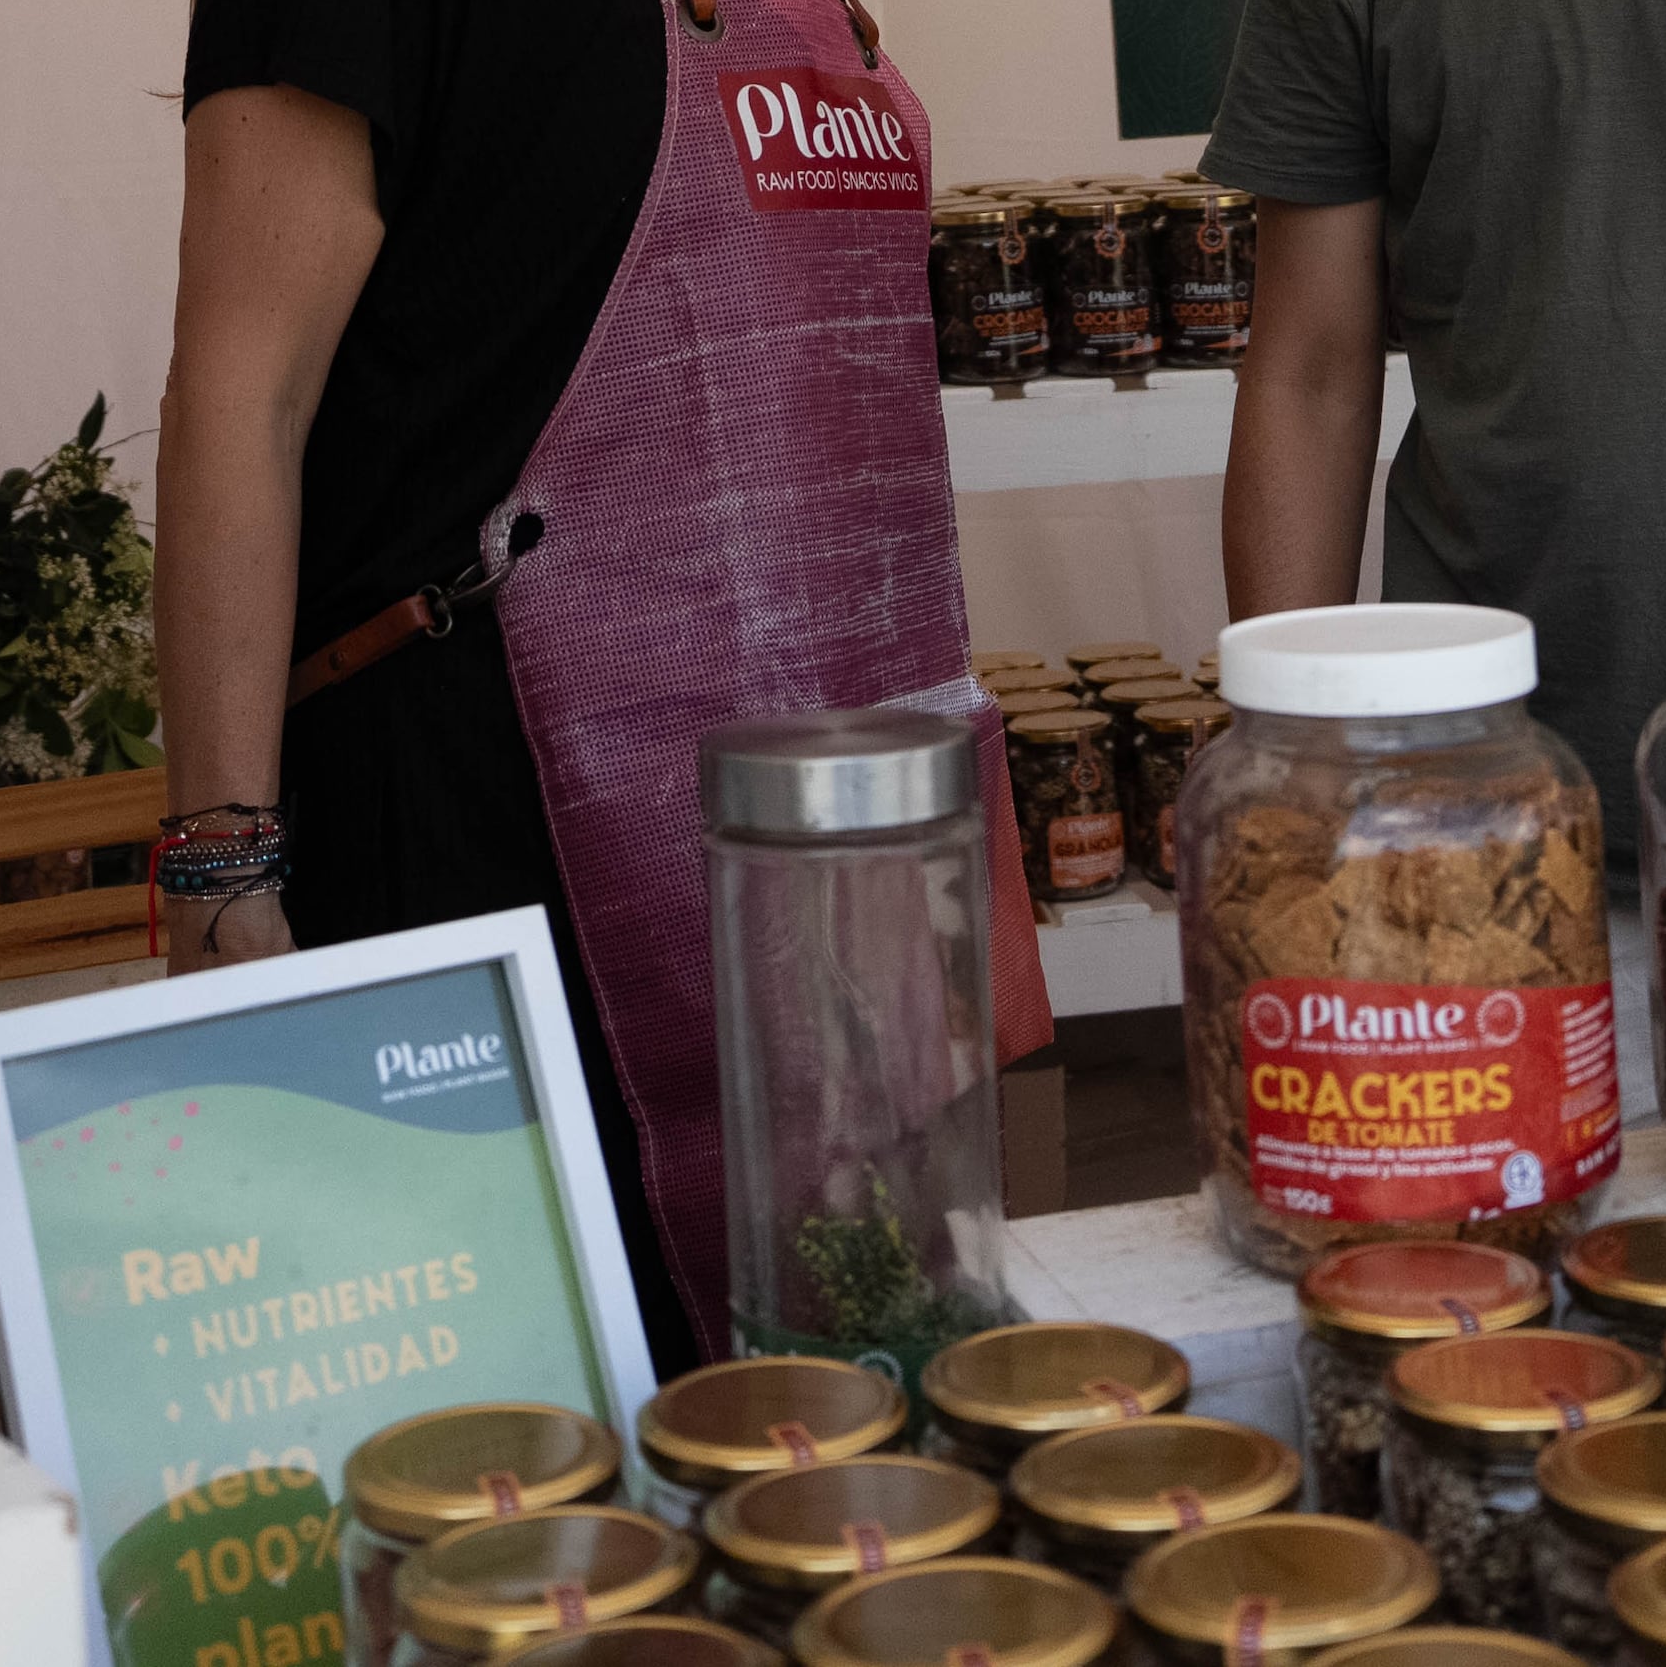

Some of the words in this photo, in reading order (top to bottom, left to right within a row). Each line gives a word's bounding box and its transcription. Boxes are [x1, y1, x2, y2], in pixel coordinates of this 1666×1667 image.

[736, 82, 911, 161] Plante
[757, 172, 795, 191] RAW
[798, 170, 835, 190] FOOD
[842, 171, 887, 191] SNACKS
[887, 173, 919, 192] VIVOS
[989, 291, 1032, 306] Plante
[1088, 290, 1136, 304] Plante
[1185, 282, 1232, 295] Plante
[1299, 992, 1465, 1041] Plante
[376, 1033, 501, 1085] Plante
[1251, 1062, 1514, 1120] CRACKERS
[1307, 1119, 1337, 1144] DE
[1346, 1120, 1456, 1147] TOMATE
[1284, 1187, 1333, 1215] 150g
[123, 1237, 262, 1306] Raw
[192, 1252, 479, 1359] NUTRIENTES
[205, 1326, 460, 1424] VITALIDAD
[162, 1444, 318, 1522] Keto
